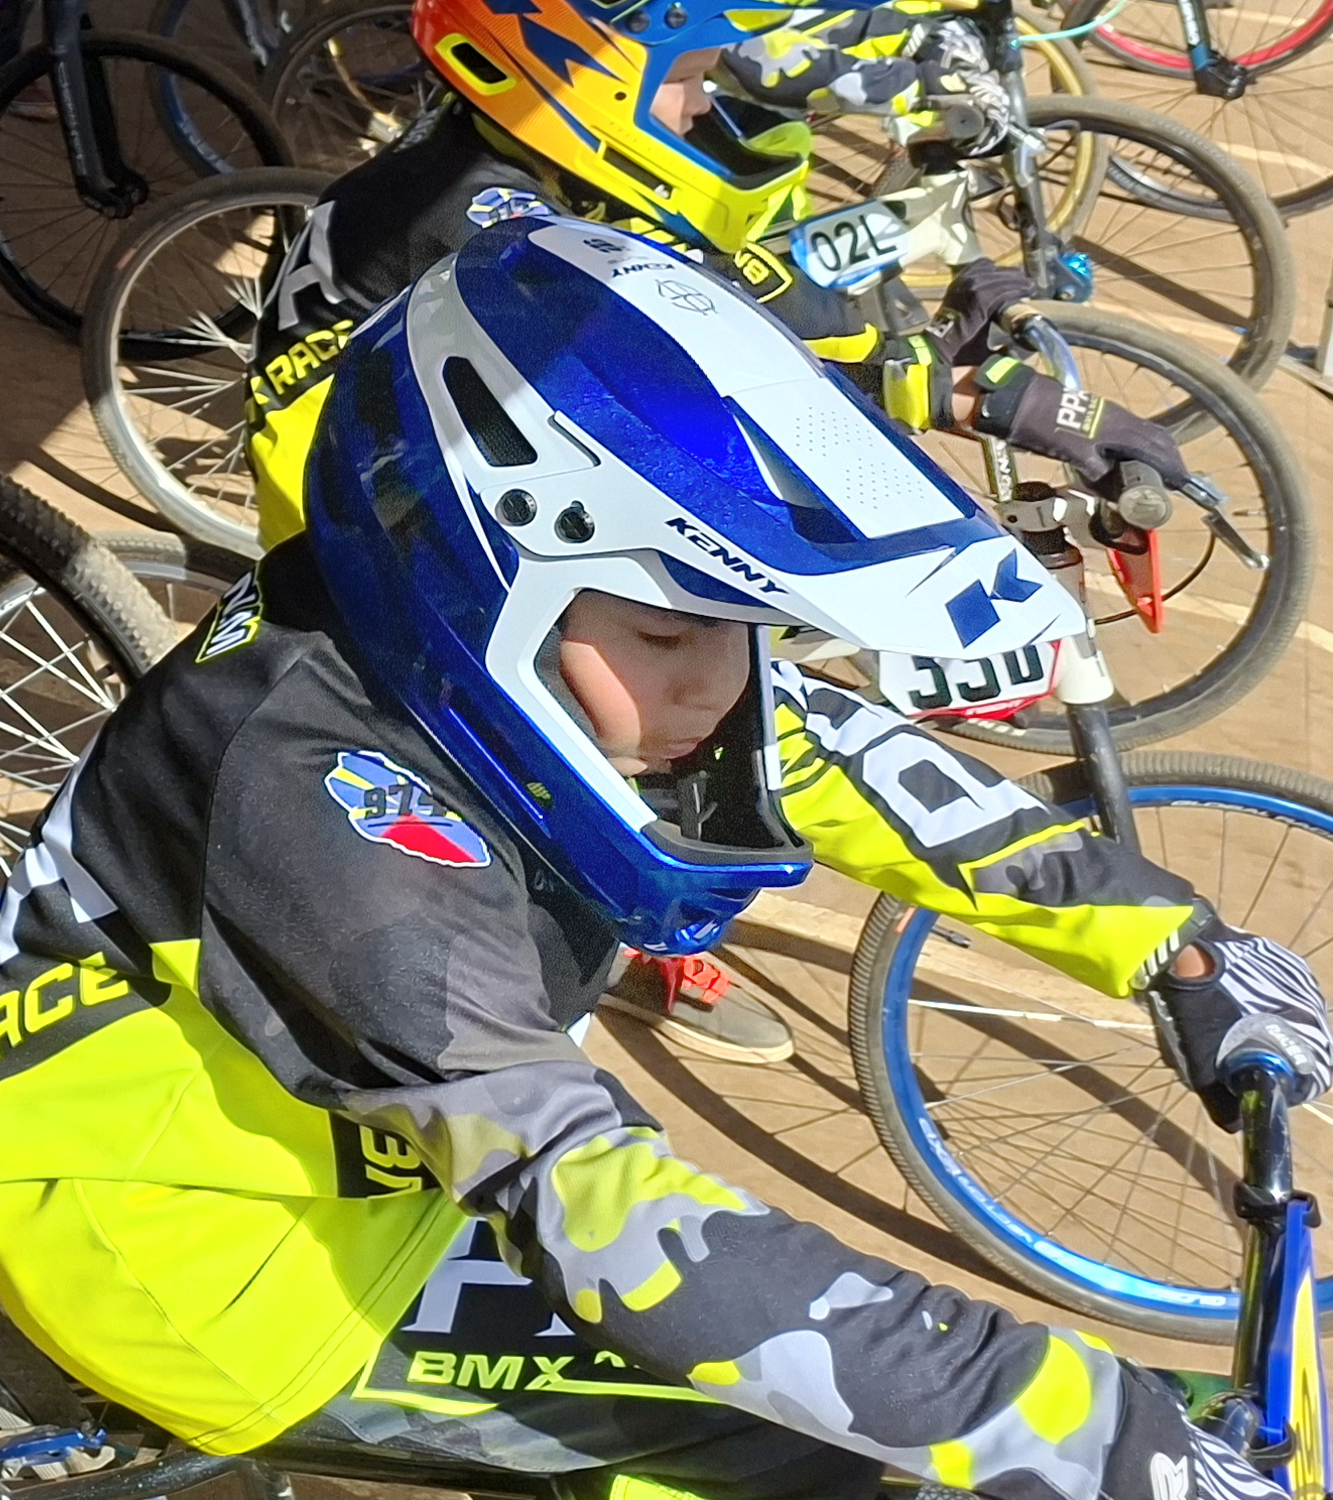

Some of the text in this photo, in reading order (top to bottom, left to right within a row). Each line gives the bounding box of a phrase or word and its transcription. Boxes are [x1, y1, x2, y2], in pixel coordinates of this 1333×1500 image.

[810, 214, 898, 272] 02L
[664, 517, 792, 596] KENNY
[405, 1351, 570, 1390] BMX
